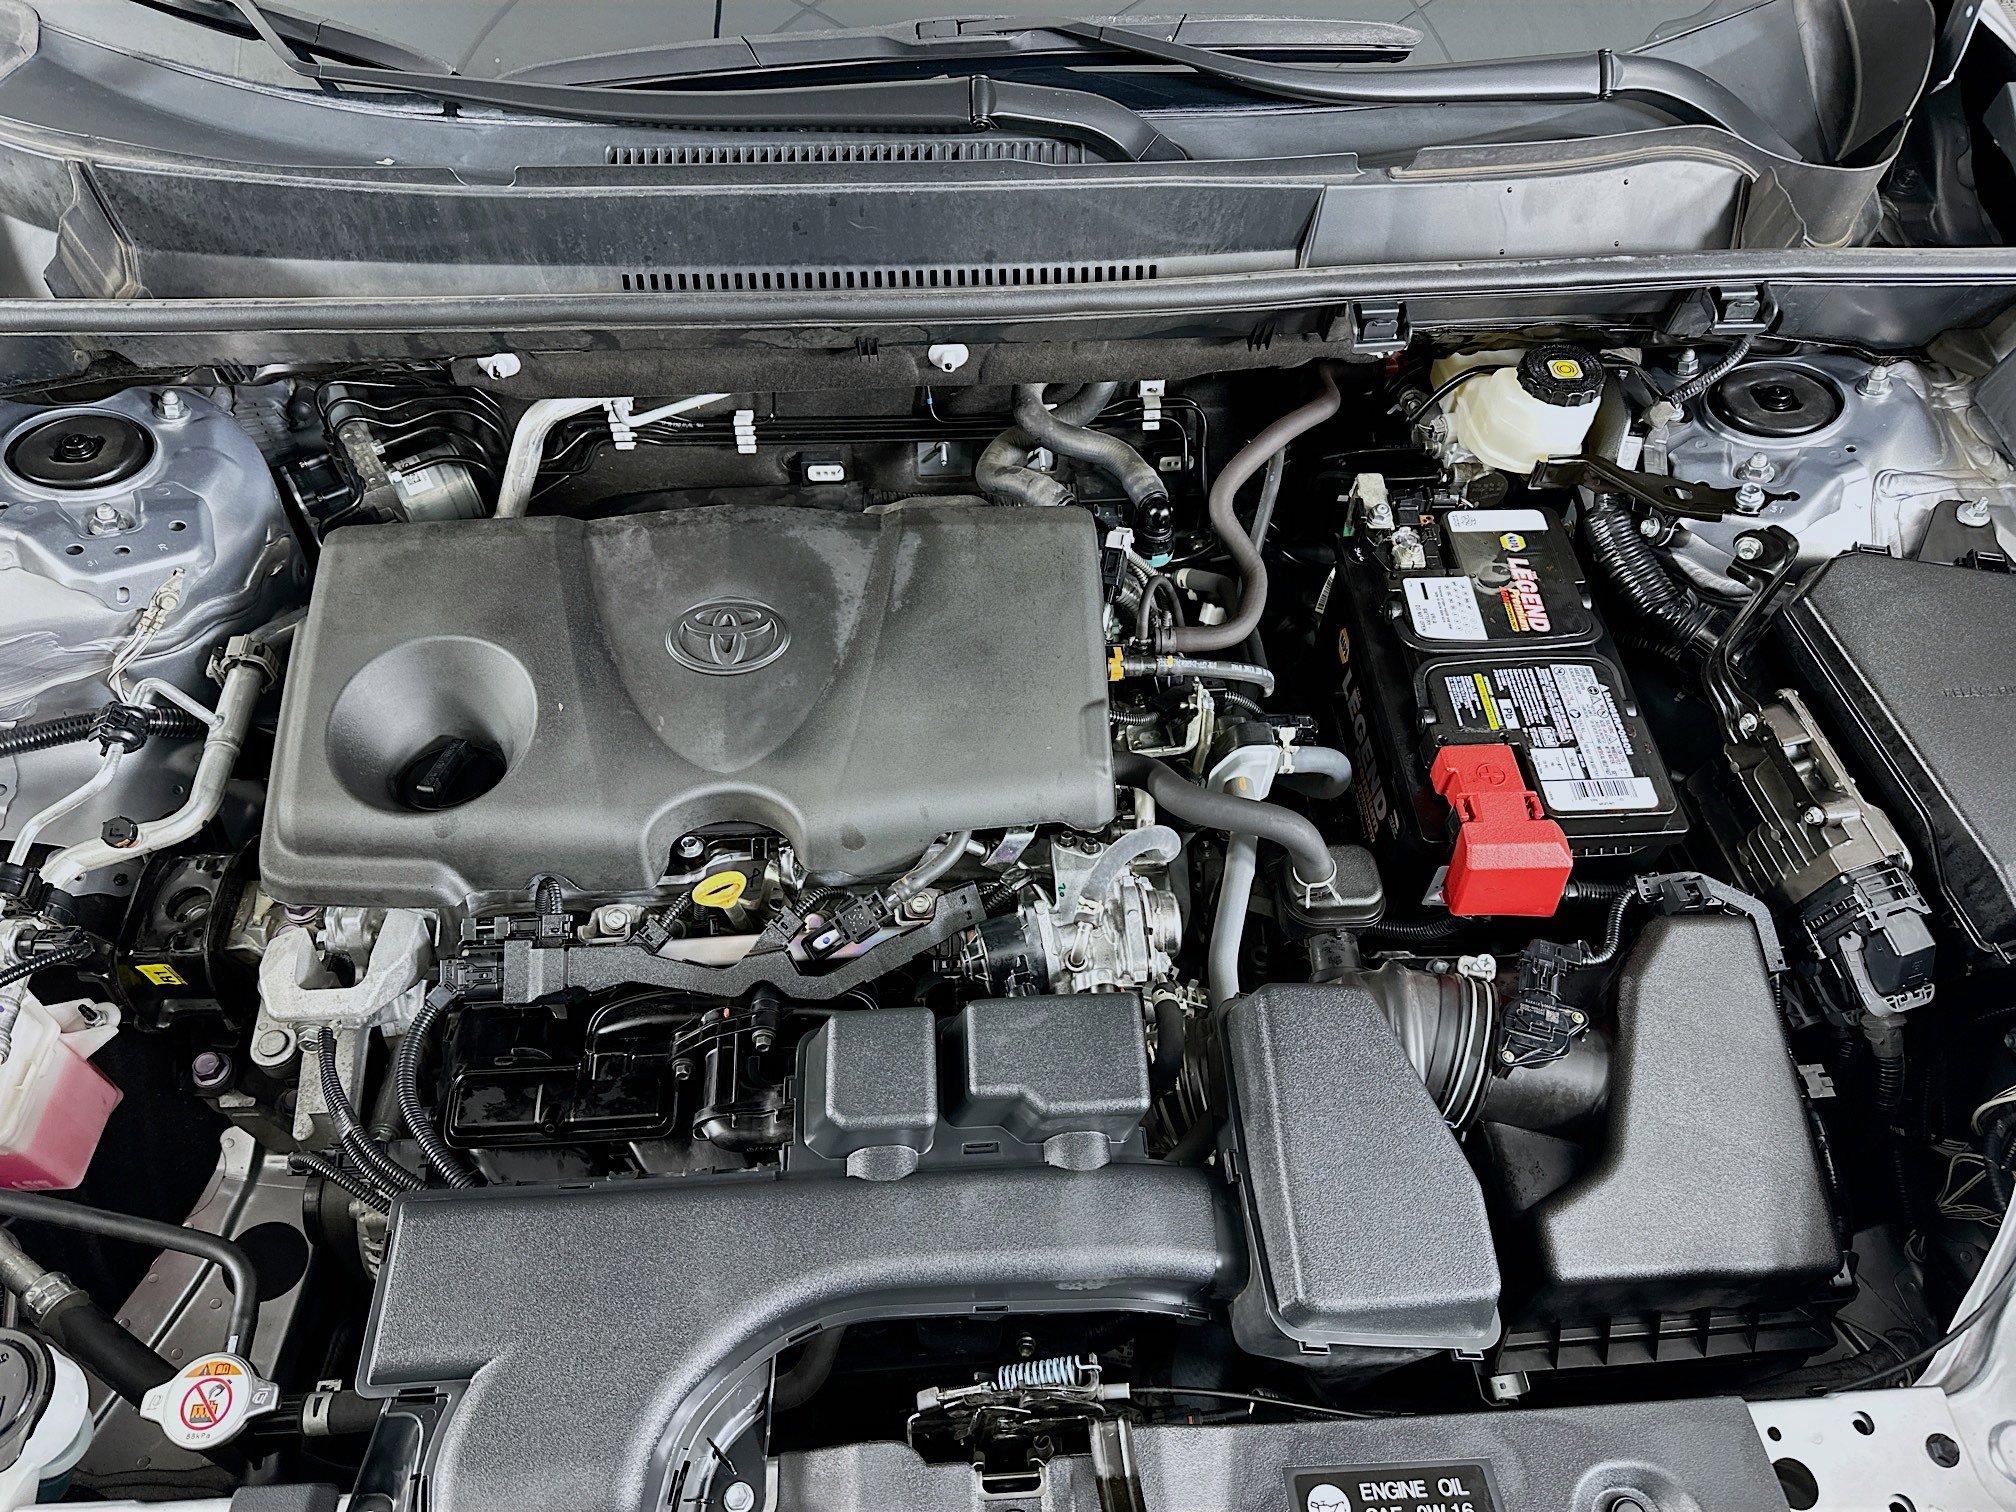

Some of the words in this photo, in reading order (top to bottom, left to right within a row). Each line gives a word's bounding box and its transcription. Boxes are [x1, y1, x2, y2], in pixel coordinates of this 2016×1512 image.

[1507, 558, 1551, 632] LEGEND
[1507, 589, 1531, 631] Premium
[1503, 708, 1513, 720] Pb
[1341, 668, 1387, 821] LEGEND
[1358, 1480, 1429, 1501] ENGINE
[1437, 1477, 1471, 1497] OIL
